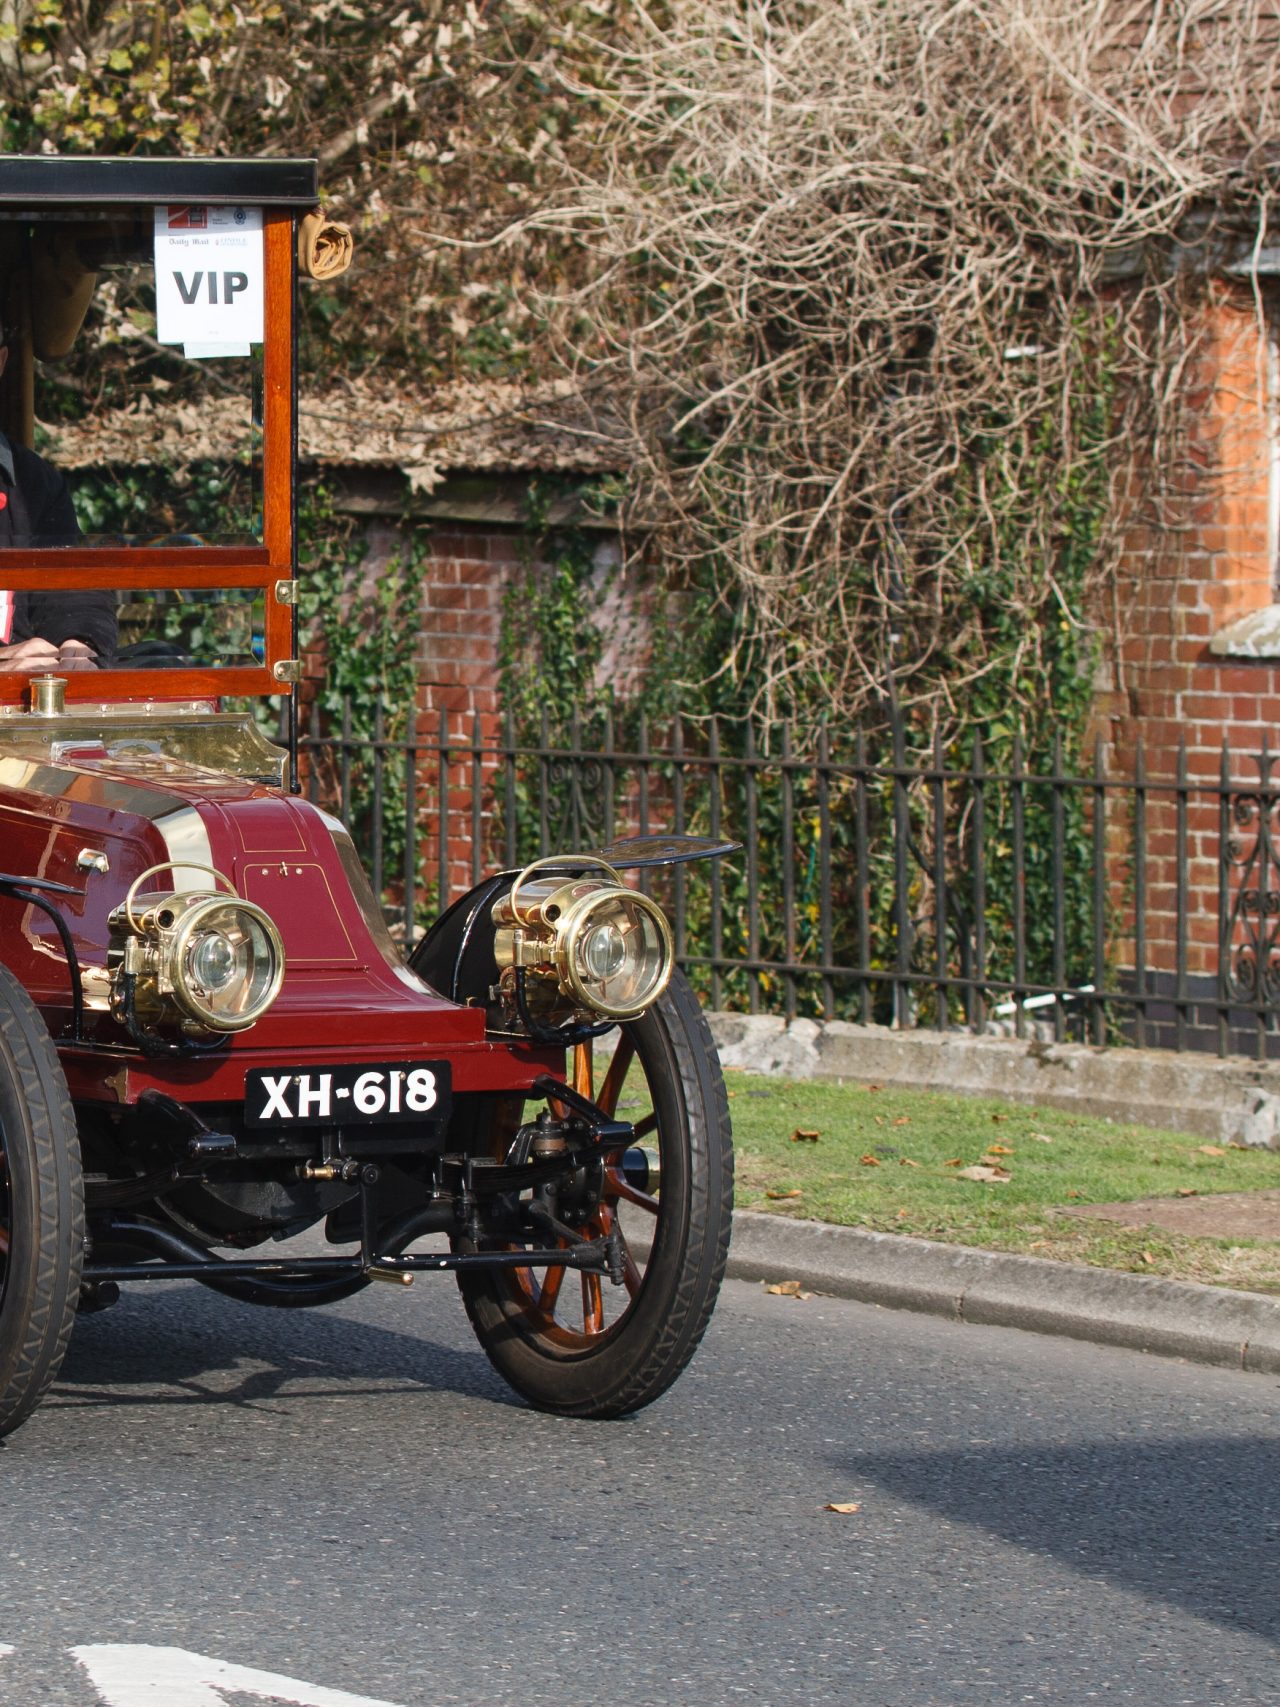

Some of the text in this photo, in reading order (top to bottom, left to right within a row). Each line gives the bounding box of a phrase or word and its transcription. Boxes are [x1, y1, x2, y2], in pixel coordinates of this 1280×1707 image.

[168, 238, 190, 247] Daily
[172, 271, 249, 305] VIP
[259, 1068, 437, 1119] XH-618
